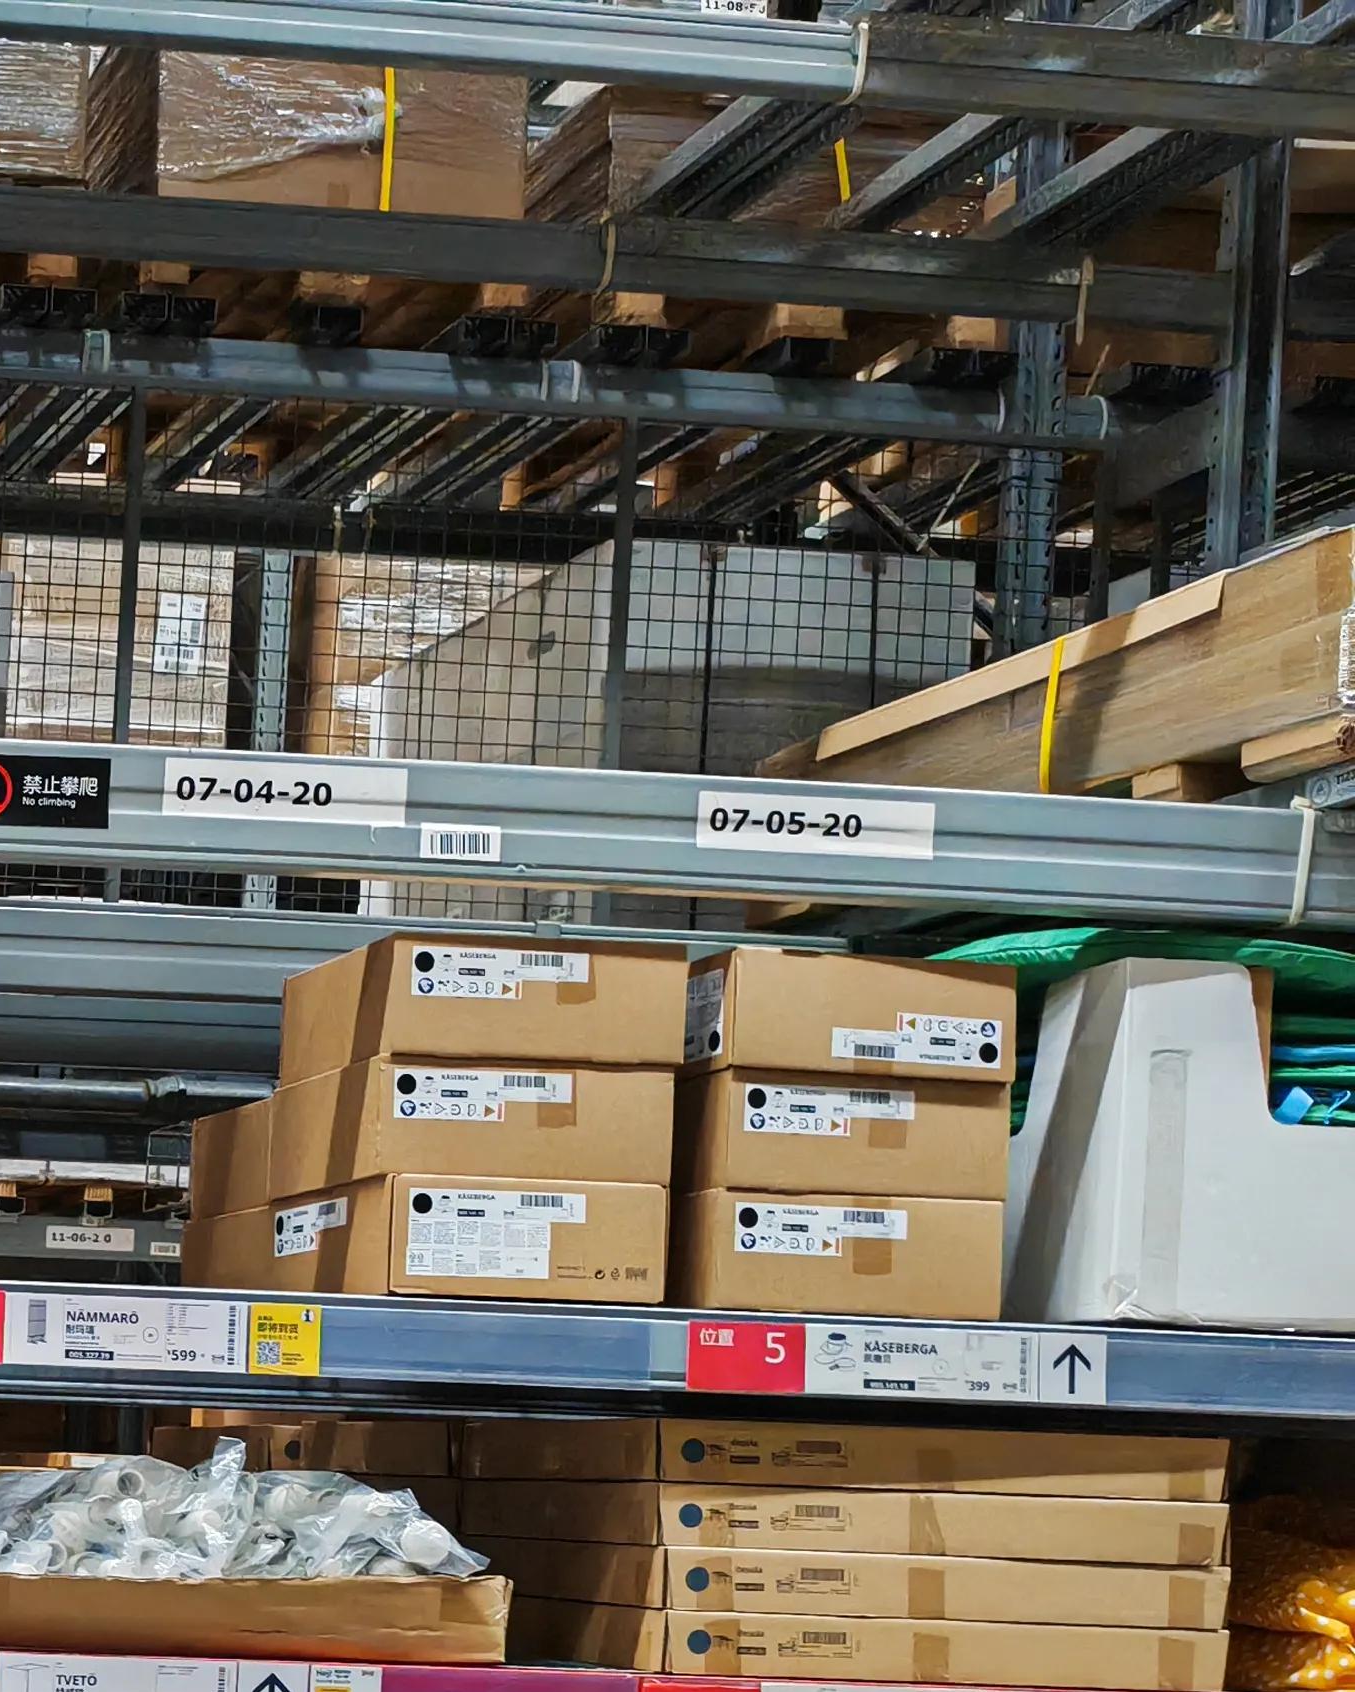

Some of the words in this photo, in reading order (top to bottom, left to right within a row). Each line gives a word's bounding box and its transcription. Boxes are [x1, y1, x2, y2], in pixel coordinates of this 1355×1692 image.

[22, 775, 98, 797] 禁止攀爬
[175, 776, 333, 806] 07-04-20
[22, 796, 36, 806] No
[37, 797, 76, 808] climbing
[709, 808, 863, 838] 07-05-20
[699, 1327, 735, 1347] 位置
[763, 1332, 787, 1363] 5
[863, 1337, 939, 1356] KÅSEBERGA
[56, 1672, 97, 1687] TVETÖ
